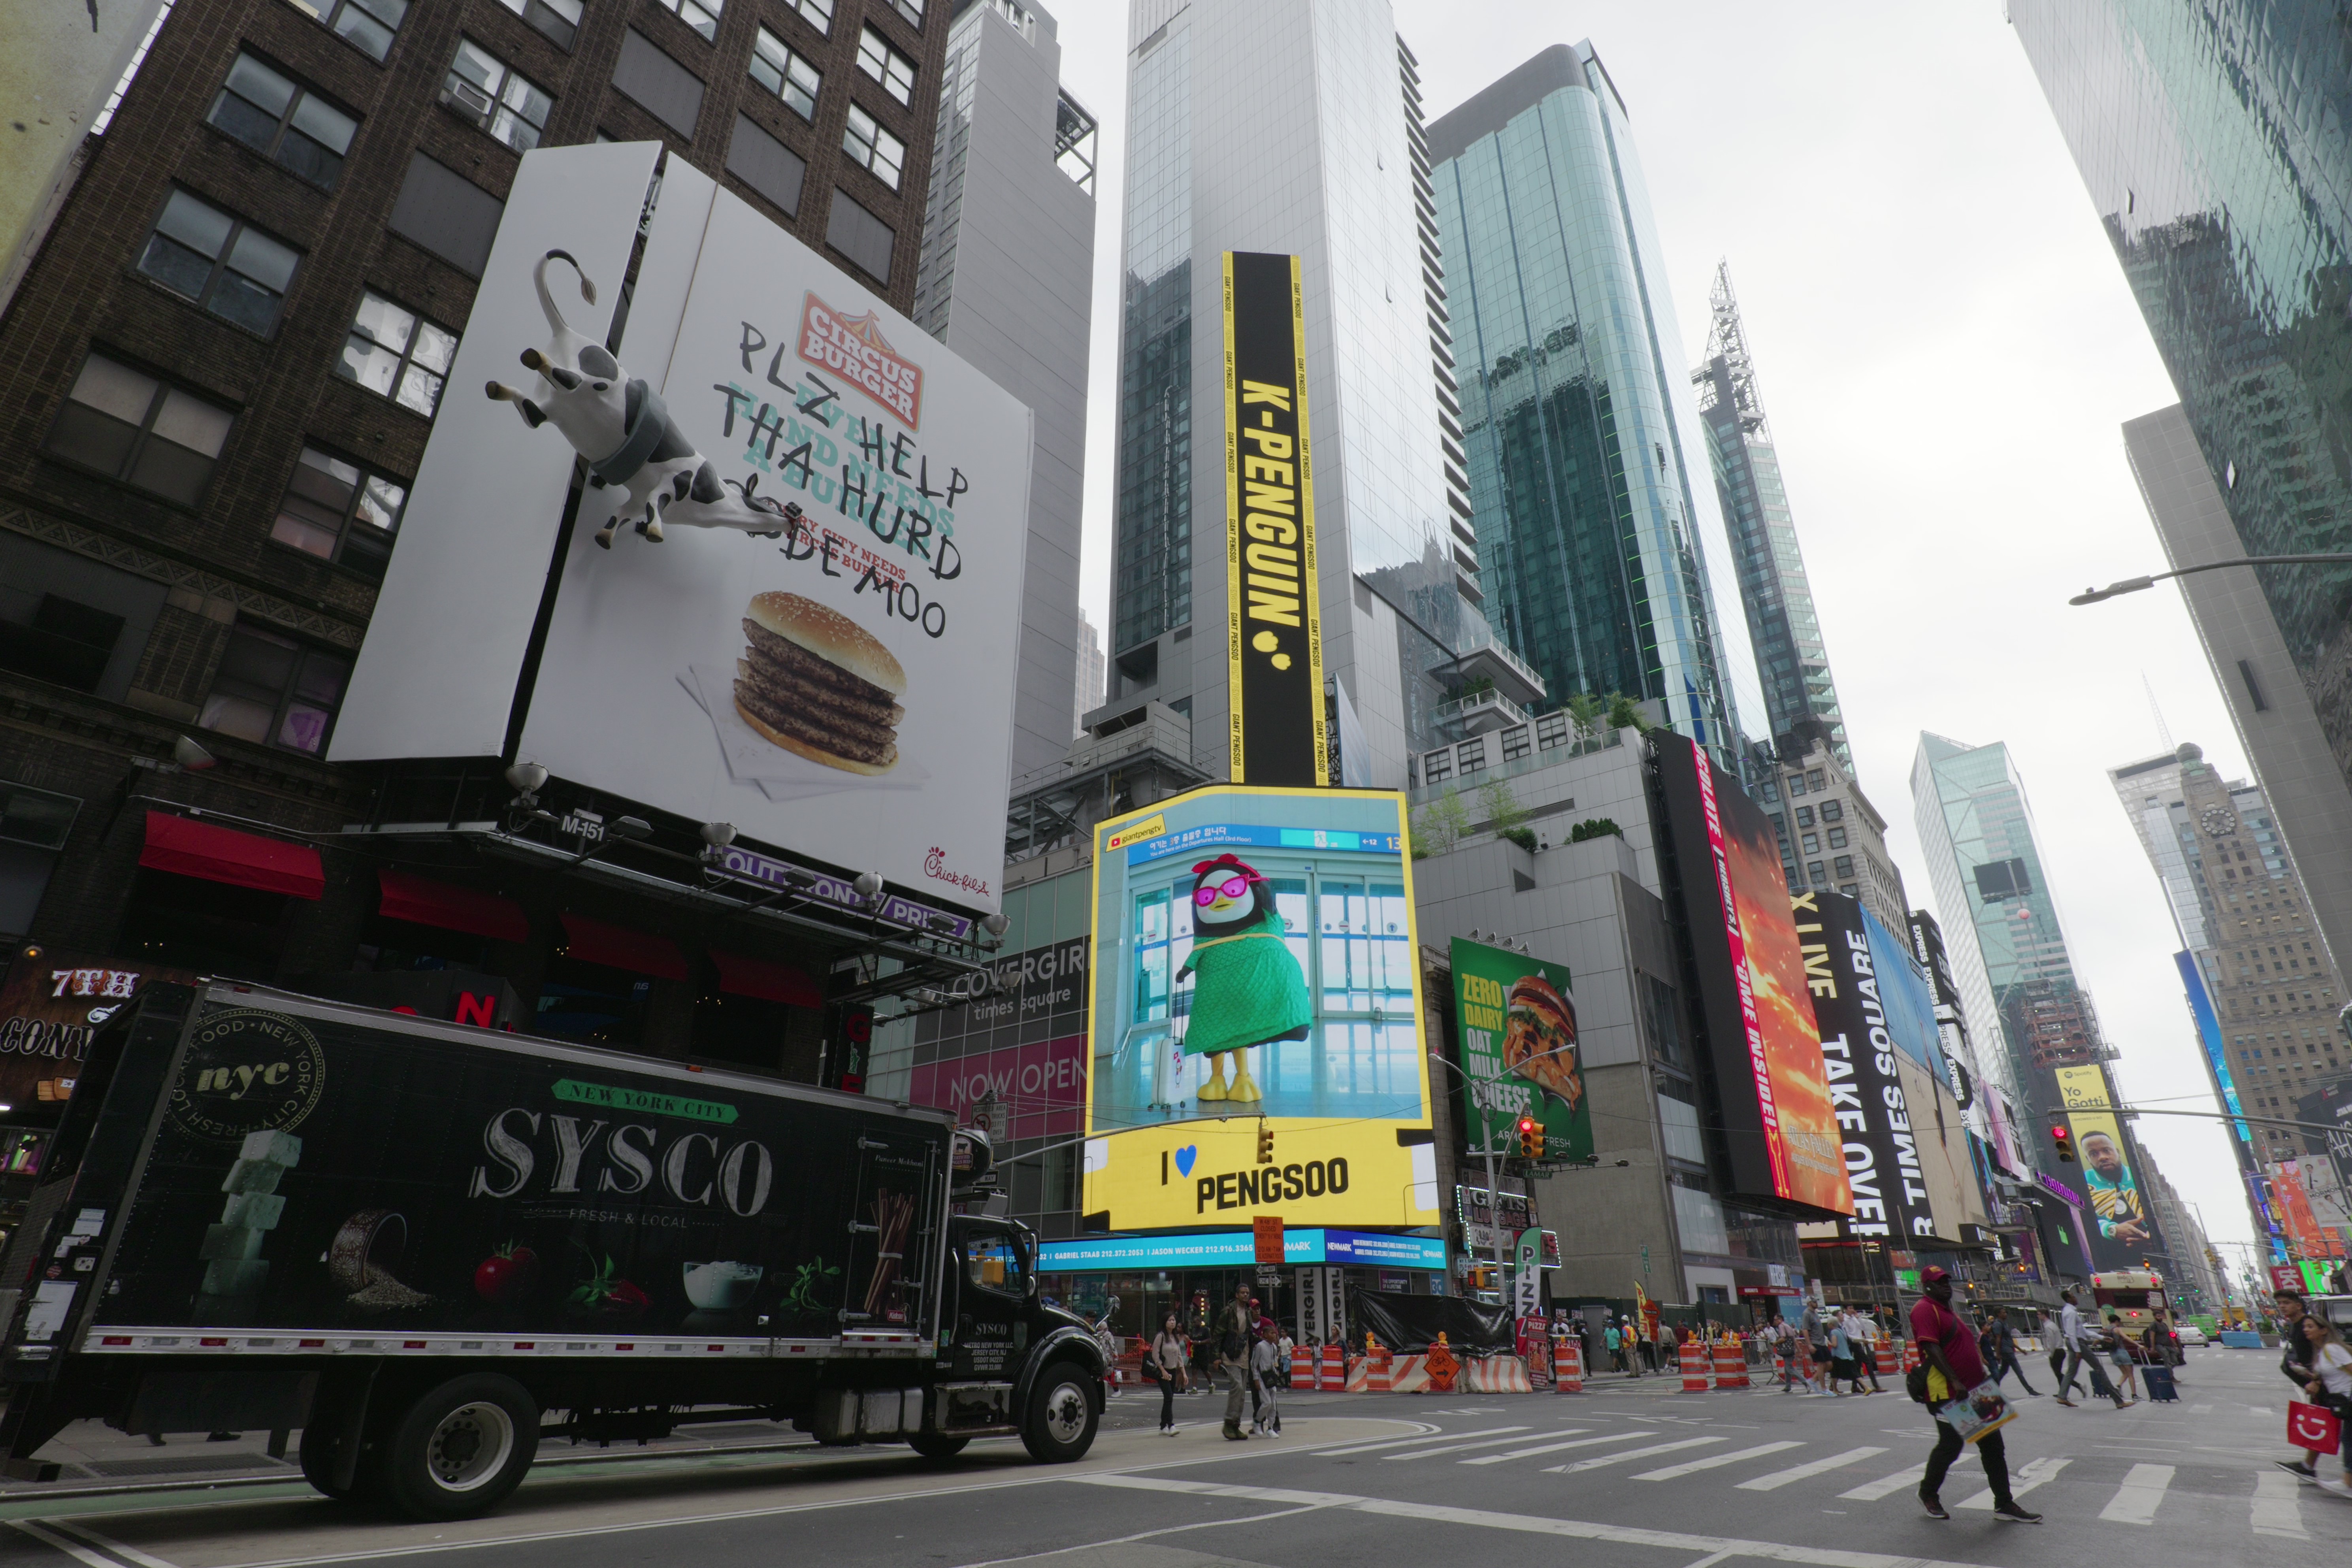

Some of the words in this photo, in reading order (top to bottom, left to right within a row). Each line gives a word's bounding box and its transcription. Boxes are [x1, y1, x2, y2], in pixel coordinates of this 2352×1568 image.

[809, 306, 915, 393] CIRCUS
[805, 330, 913, 424] BURGER
[740, 321, 839, 428] PLZ
[859, 416, 968, 509] HELP
[714, 384, 814, 488] THA
[840, 465, 961, 579] HURD
[1243, 380, 1300, 627] K-PENGUIN
[793, 529, 839, 560] IRCUS
[861, 547, 906, 581] NEEDS
[780, 524, 841, 577] DE
[854, 565, 946, 638] MOO
[562, 815, 604, 841] M-151
[1122, 825, 1161, 843] giantpengtv
[1150, 840, 1167, 850] 여기는
[1204, 827, 1226, 837] 입니다
[1189, 837, 1213, 848] Departures
[924, 850, 989, 897] Chick-fil-A
[1913, 925, 1929, 963] EXPRESS
[1462, 973, 1502, 1007] ZERO
[1923, 967, 1939, 1005] EXPRESS
[974, 1001, 1013, 1021] times
[1021, 988, 1071, 1013] square
[1464, 1003, 1502, 1031] DAIRY
[1846, 930, 1898, 1078] SQUARE
[260, 1021, 300, 1048] NEW
[1466, 1027, 1491, 1053] OAT
[196, 1062, 289, 1100] nyc
[294, 1050, 311, 1095] YORK
[950, 1068, 1013, 1105] NOW
[1021, 1056, 1087, 1093] OPEN
[1469, 1053, 1501, 1081] MILK
[1748, 1030, 1777, 1128] INSIDE!
[1947, 1059, 1964, 1101] EXPRESS
[569, 1085, 613, 1102] NEW
[624, 1093, 675, 1112] YORK
[684, 1102, 726, 1118] CITY
[2064, 1087, 2081, 1097] Yo
[2068, 1096, 2103, 1108] Gotti
[262, 1100, 298, 1130] CITY
[1545, 1136, 1571, 1148] FRESH
[1883, 1086, 1925, 1205] TIMES
[468, 1108, 773, 1216] SYSCO
[875, 1155, 896, 1163] Paneer
[898, 1157, 923, 1167] Makhani
[1525, 1169, 1549, 1178] LAMAR
[1162, 1151, 1168, 1185] I
[1197, 1157, 1349, 1214] PENGSOO
[2309, 1187, 2341, 1199] MORMON
[569, 1209, 618, 1223] FRESH
[626, 1213, 633, 1224] &
[642, 1215, 688, 1227] LOCAL
[1474, 1207, 1527, 1227] LUGAGE
[1055, 1251, 1079, 1259] GABRIEL
[1101, 1249, 1144, 1258] 212.372.2053
[1175, 1246, 1203, 1255] WECKER
[1206, 1244, 1253, 1253] 212.916.3365
[1327, 1242, 1352, 1251] NEWMARK
[1303, 1268, 1315, 1346] VERGIRL
[976, 1324, 1007, 1335] SYSCO
[1528, 1321, 1546, 1330] PIZZA
